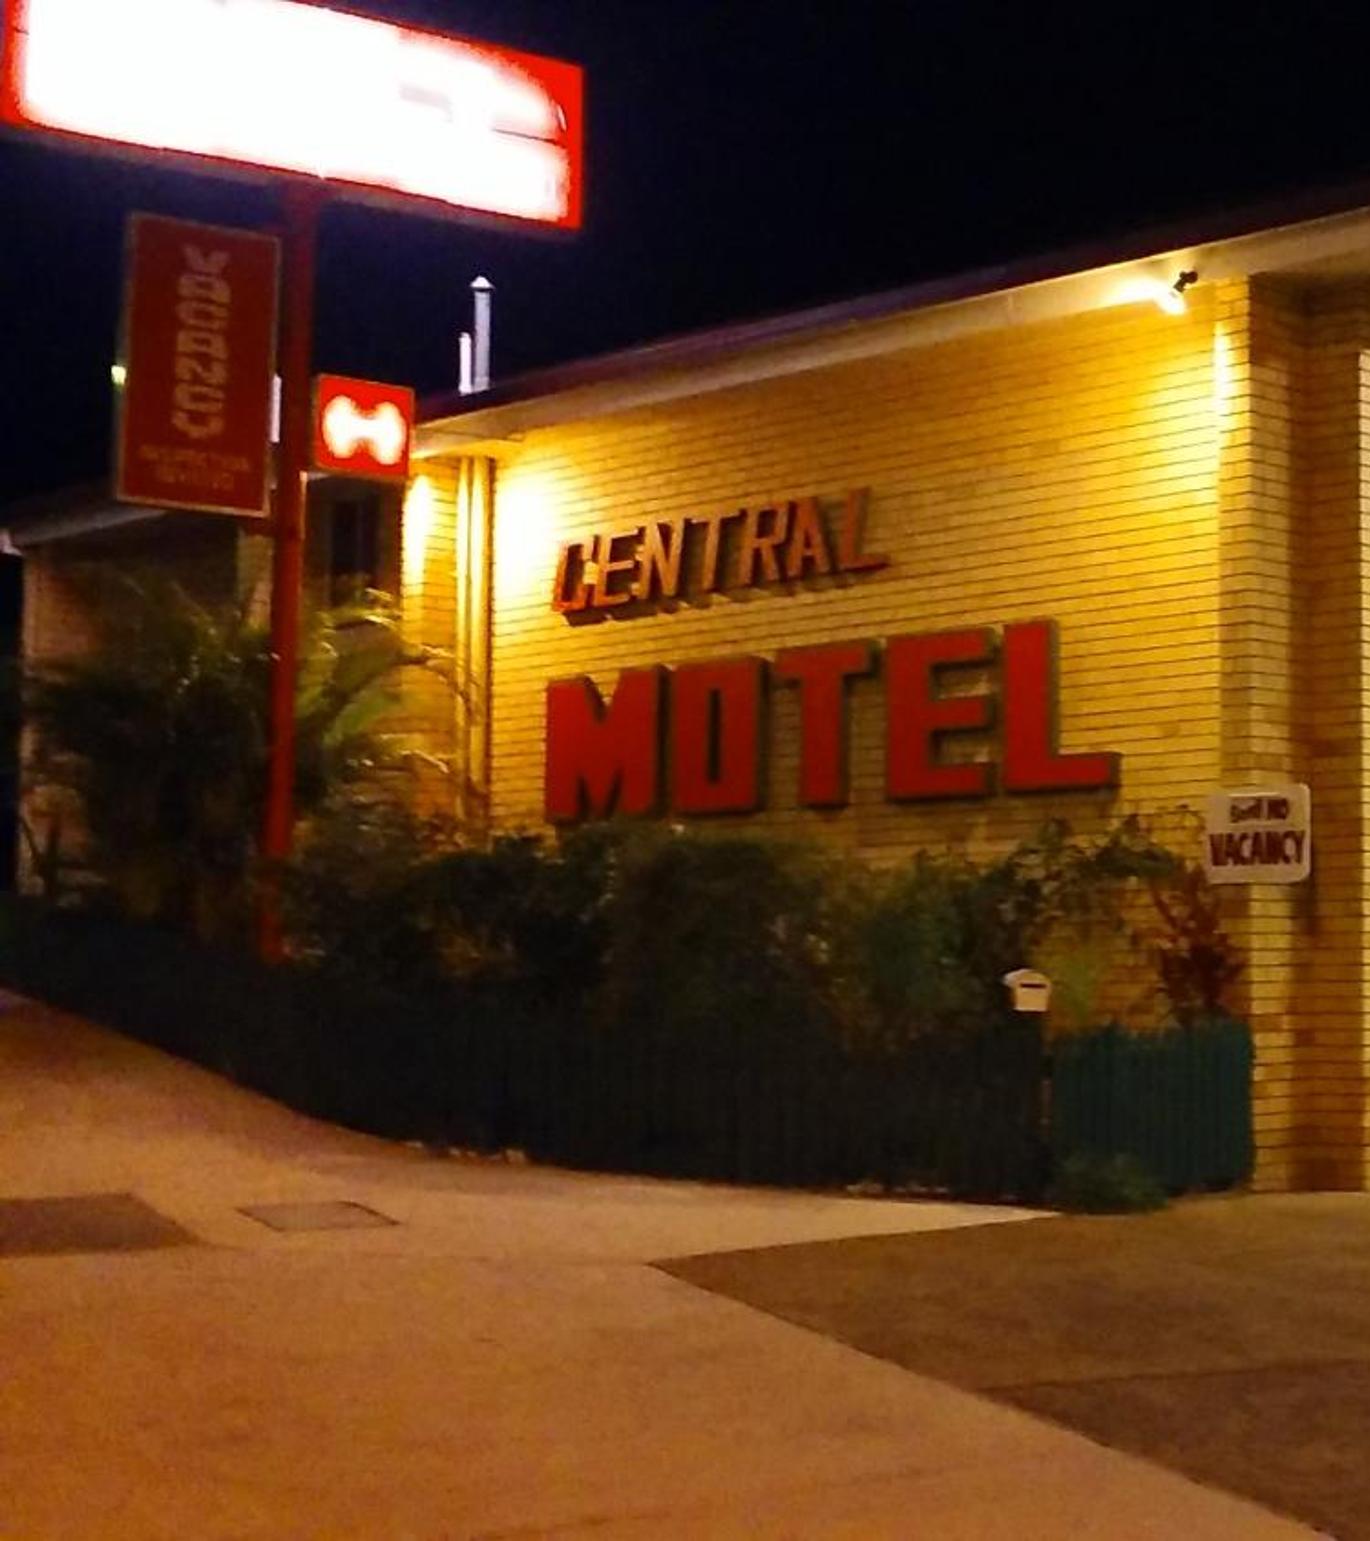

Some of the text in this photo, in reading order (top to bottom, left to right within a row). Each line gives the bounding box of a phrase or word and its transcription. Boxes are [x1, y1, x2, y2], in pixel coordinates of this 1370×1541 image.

[552, 486, 892, 614] CENTRAL
[545, 617, 1120, 825] MOTEL
[1208, 829, 1306, 867] VACANCY
